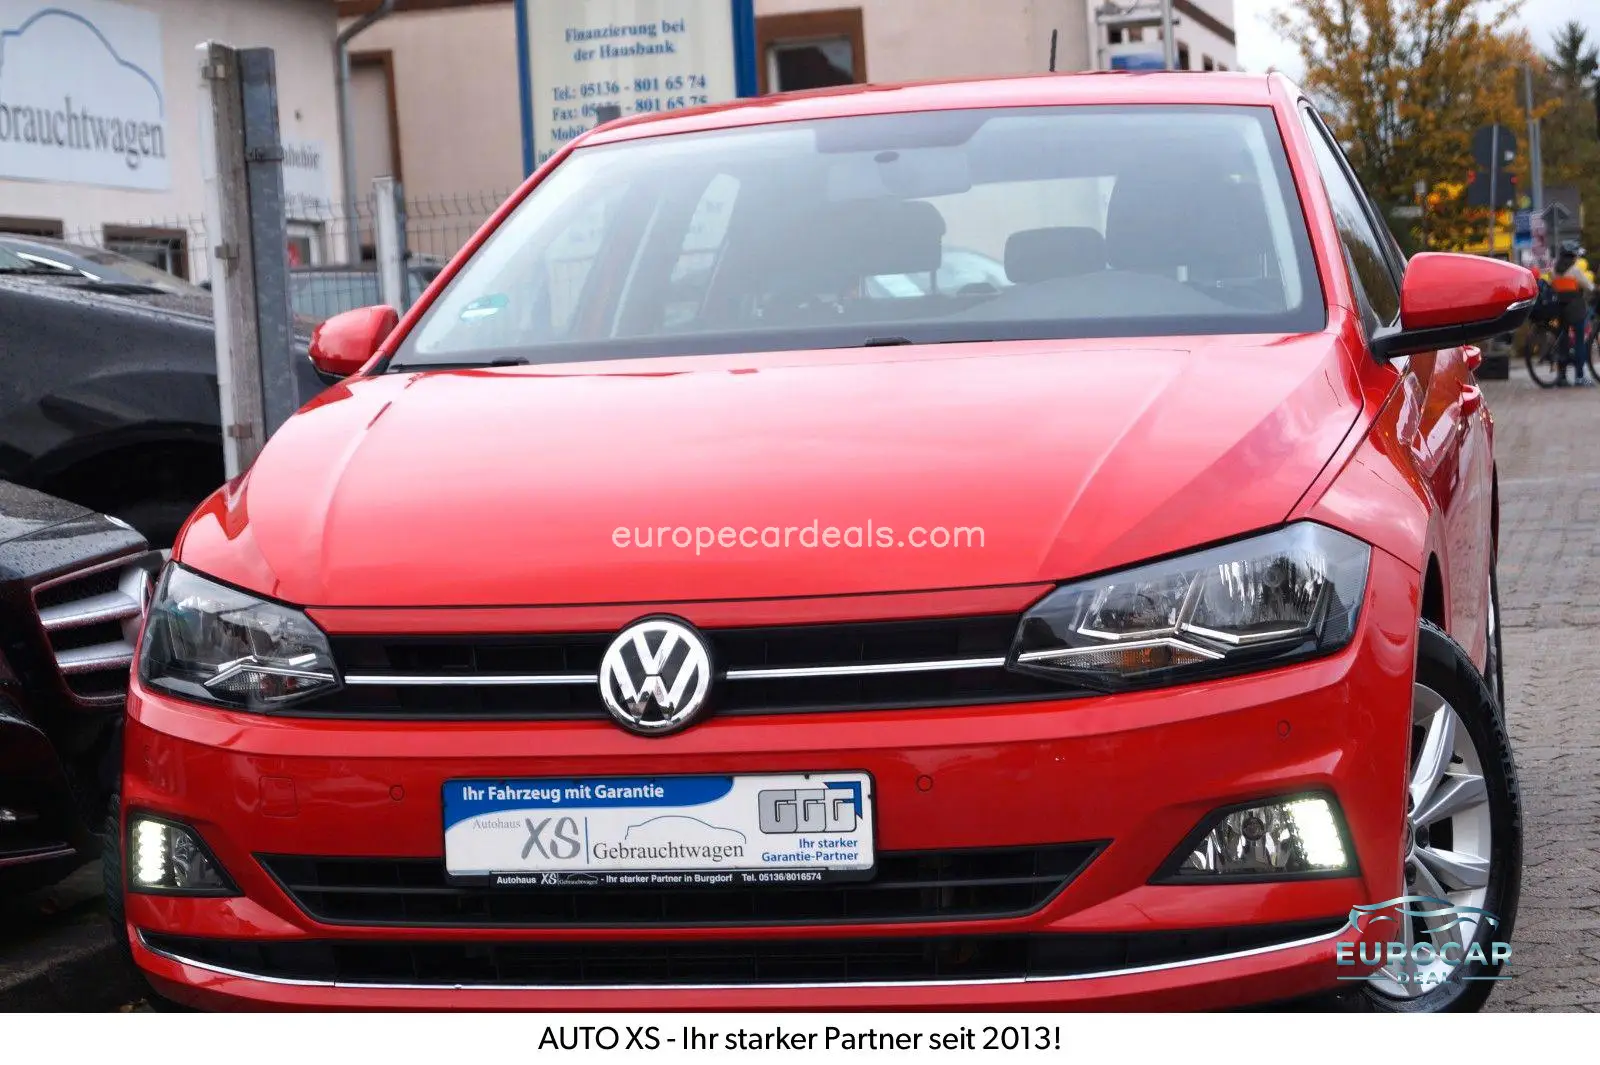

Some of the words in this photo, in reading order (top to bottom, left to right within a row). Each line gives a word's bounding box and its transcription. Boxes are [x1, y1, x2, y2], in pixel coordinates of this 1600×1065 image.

[565, 22, 657, 42] Finanzierung
[662, 18, 685, 33] bei
[574, 48, 595, 62] der
[600, 40, 675, 59] Hausbank
[580, 80, 620, 97] 05136
[634, 77, 659, 92] 801
[665, 75, 684, 90] 65
[688, 73, 706, 89] 74
[552, 106, 578, 121] Fax:
[635, 97, 660, 112] 801
[551, 124, 590, 141] Mobil
[463, 786, 485, 801] Ihr
[488, 785, 561, 803] Fahrzeug
[565, 785, 591, 799] mit
[594, 783, 665, 799] Garantie
[472, 818, 521, 830] Autohaus
[521, 816, 581, 860] XS
[799, 838, 815, 849] Ihr
[817, 838, 859, 849] starker
[592, 841, 744, 863] Gebrauchtwagen
[761, 850, 859, 863] Garantie-Partner
[496, 876, 537, 885] Autohaus
[540, 872, 557, 886] XS
[606, 874, 618, 883] Ihr
[620, 874, 649, 883] starker
[651, 874, 682, 883] Partner
[684, 874, 692, 883] in
[694, 873, 733, 884] Burgdorf
[742, 873, 757, 882] Tel.
[758, 872, 822, 882] 05136/8016574
